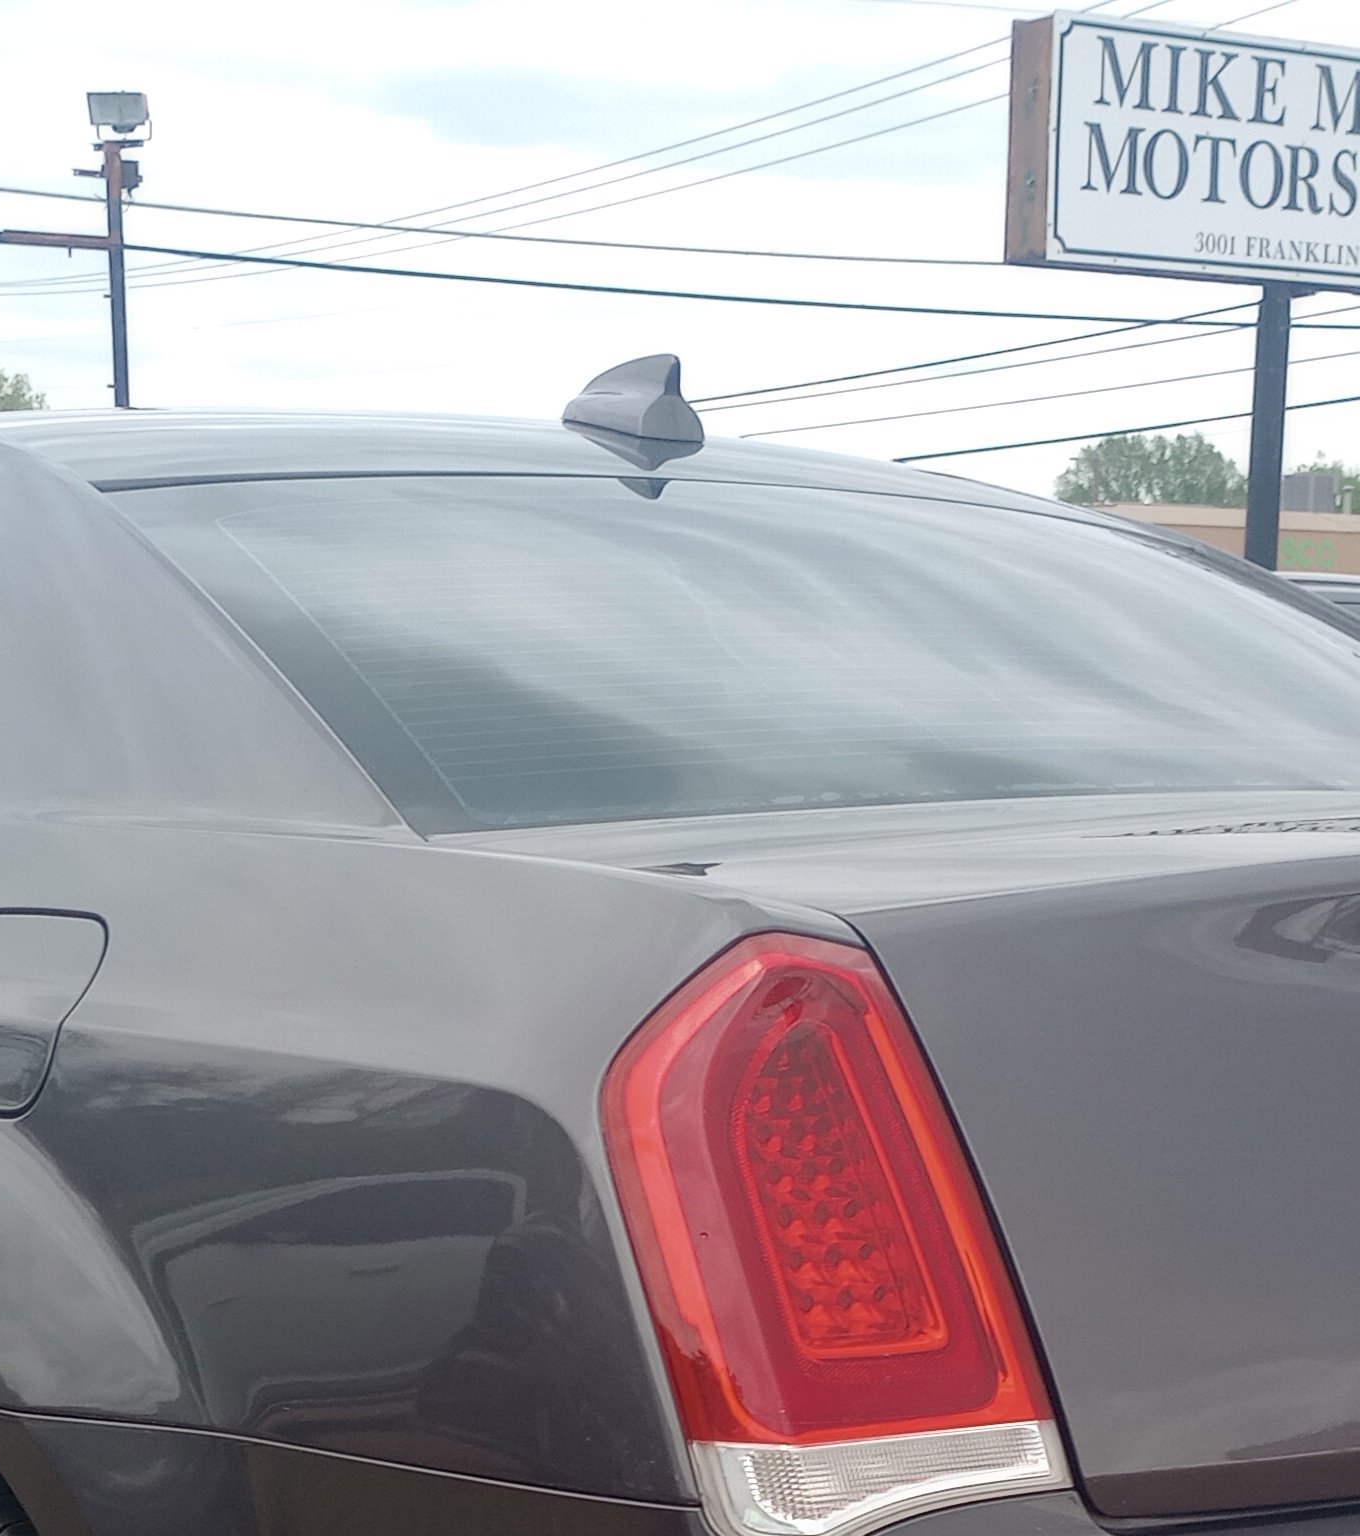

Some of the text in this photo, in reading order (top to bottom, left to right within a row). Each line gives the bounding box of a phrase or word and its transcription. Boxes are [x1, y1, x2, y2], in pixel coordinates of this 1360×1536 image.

[1093, 35, 1288, 128] MIKE
[1194, 231, 1237, 257] 3001
[1245, 236, 1360, 268] FRANKLIN
